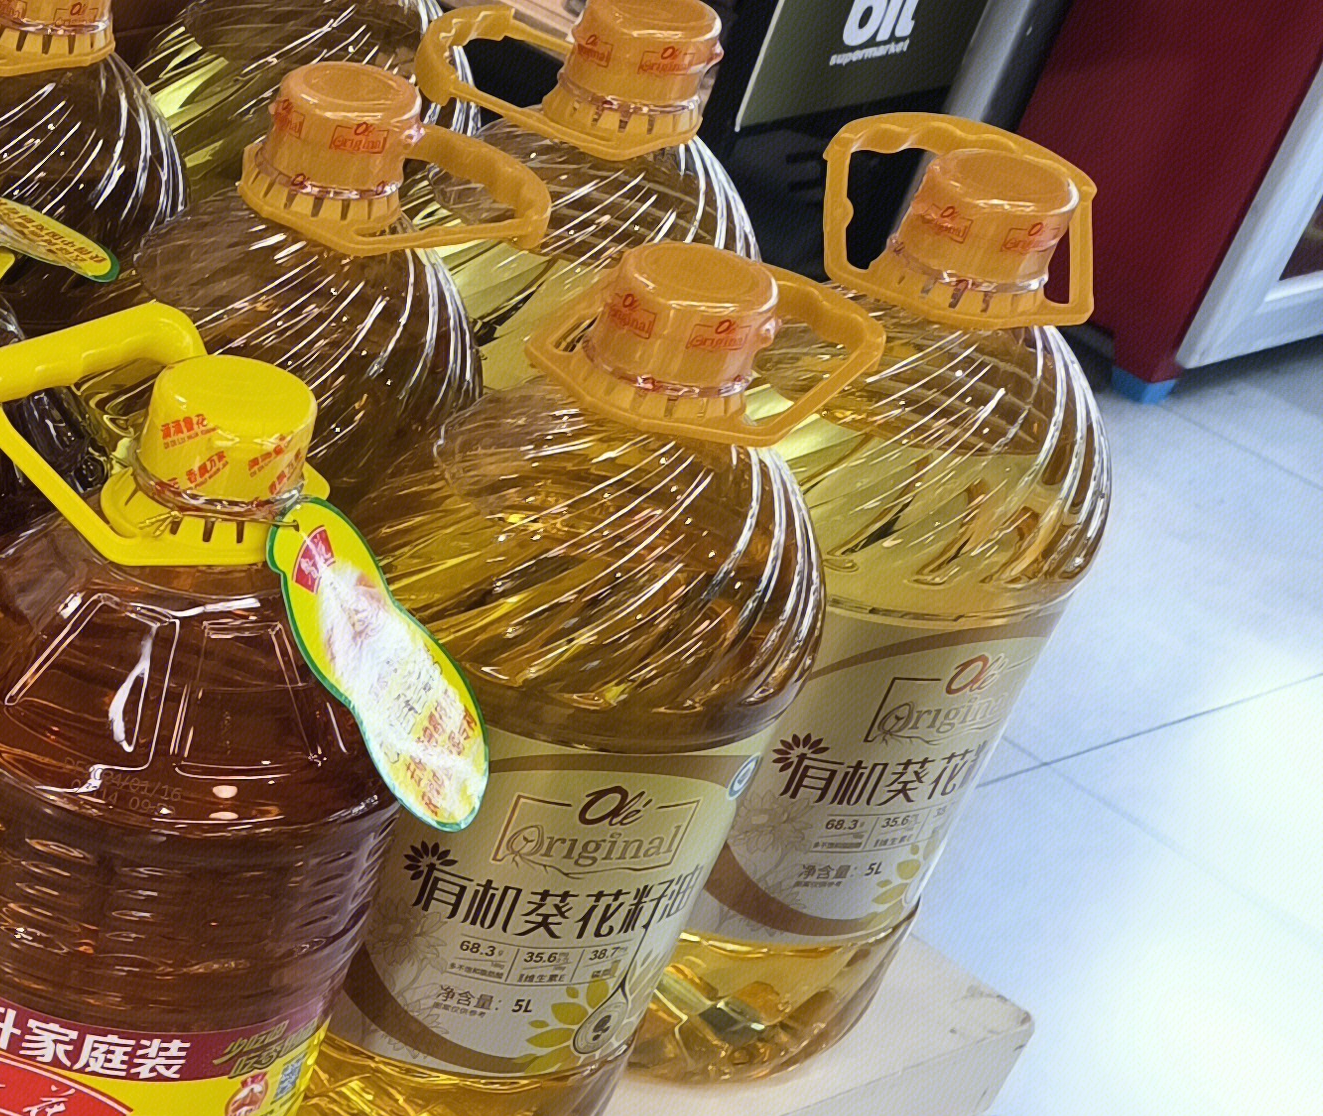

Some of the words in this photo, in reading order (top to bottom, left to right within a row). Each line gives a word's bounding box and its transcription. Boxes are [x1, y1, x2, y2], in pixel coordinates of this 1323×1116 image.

[829, 39, 910, 66] supermarket
[578, 785, 653, 827] Olé
[505, 823, 682, 868] Original
[863, 861, 883, 877] 5L
[409, 863, 704, 941] 有机葵花籽油
[511, 998, 534, 1014] 5L
